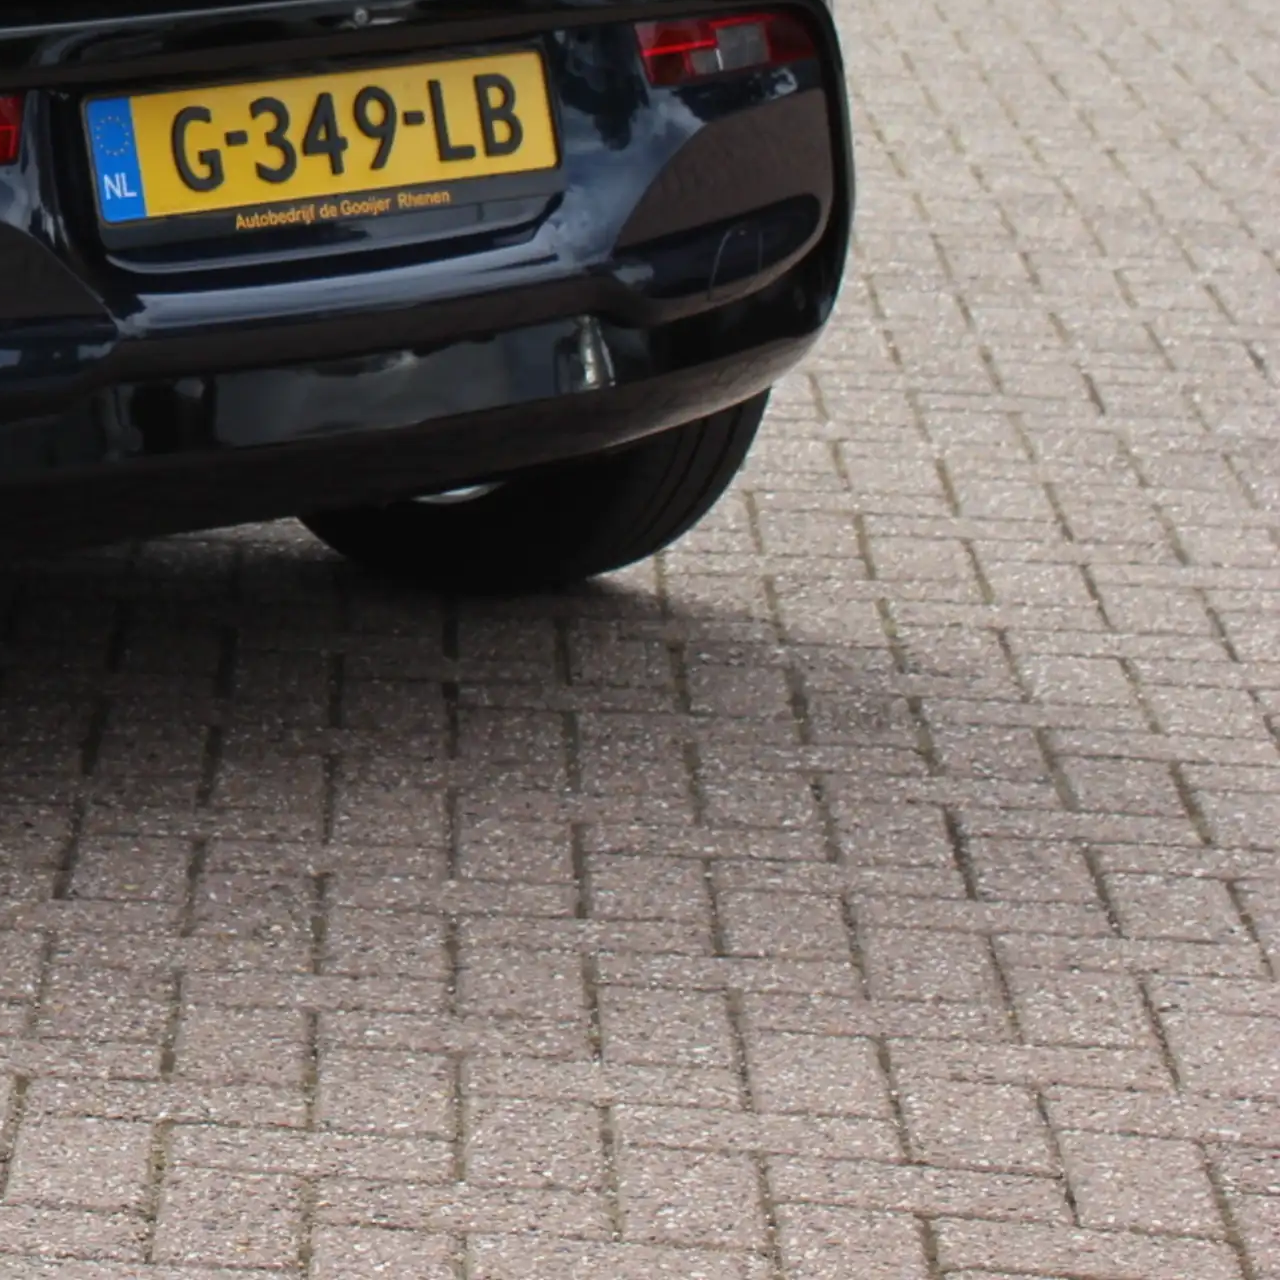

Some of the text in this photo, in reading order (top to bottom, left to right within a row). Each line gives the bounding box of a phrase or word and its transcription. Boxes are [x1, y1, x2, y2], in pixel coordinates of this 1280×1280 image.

[171, 72, 524, 193] G-349-LB
[103, 172, 138, 201] NL
[235, 189, 451, 230] Autobedrijf de Gooijer Rhenen
